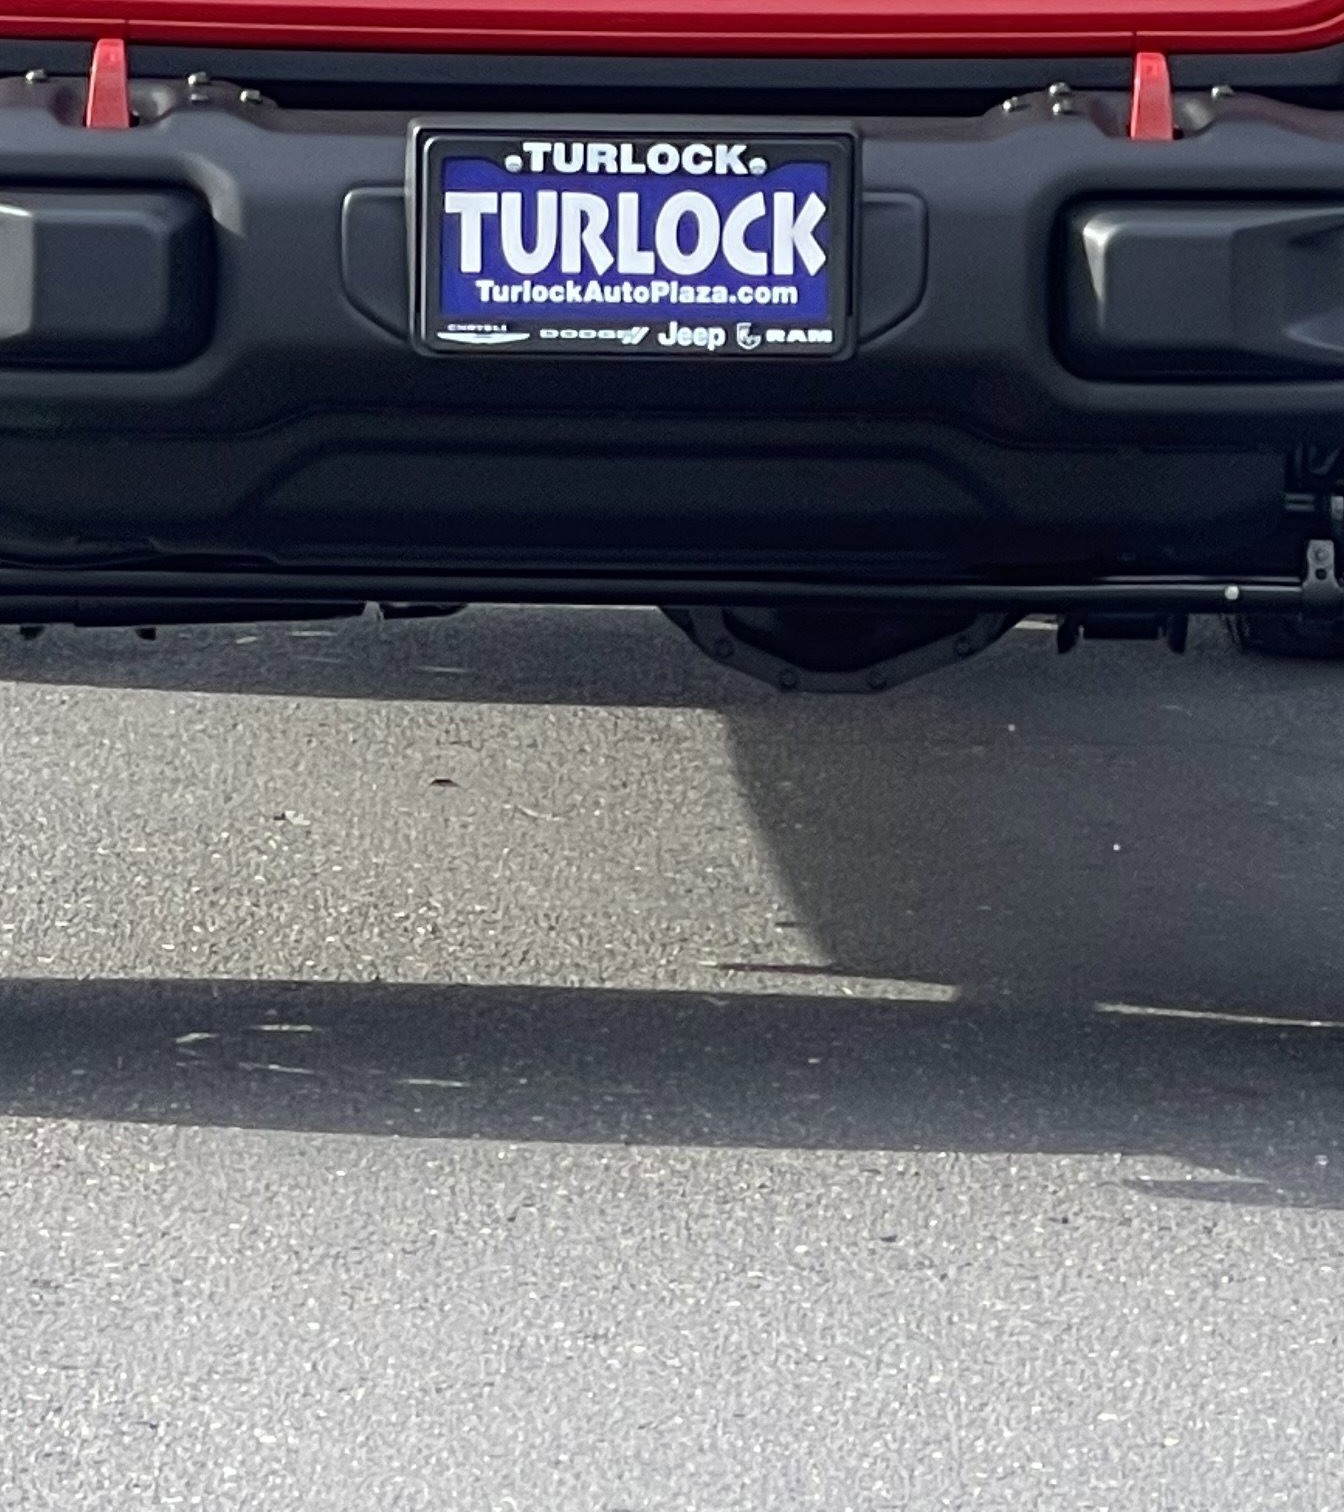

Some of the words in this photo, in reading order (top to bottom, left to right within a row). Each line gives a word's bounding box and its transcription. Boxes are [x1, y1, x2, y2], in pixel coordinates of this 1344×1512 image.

[523, 143, 748, 175] TURLOCK
[444, 190, 827, 276] TURLOCK
[475, 280, 798, 305] TurlockAutoPlaza.com
[658, 321, 727, 351] Jeep
[766, 328, 833, 344] RAM
